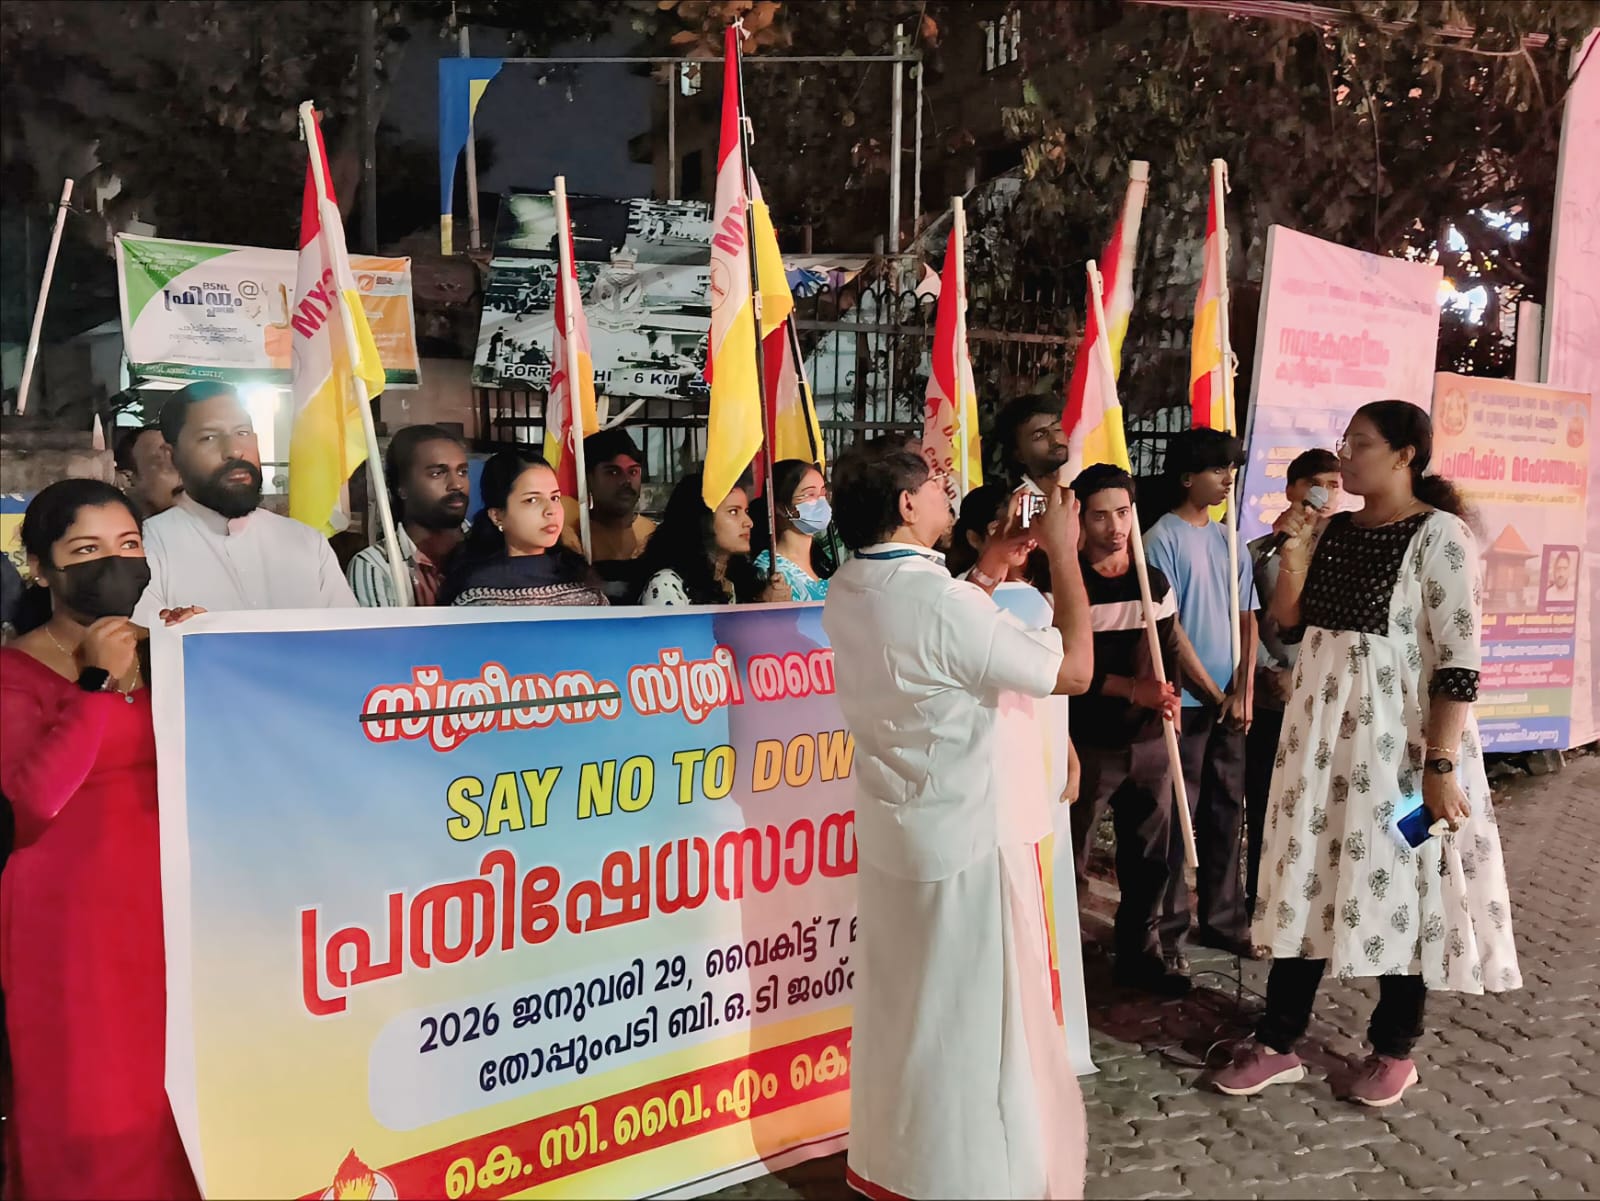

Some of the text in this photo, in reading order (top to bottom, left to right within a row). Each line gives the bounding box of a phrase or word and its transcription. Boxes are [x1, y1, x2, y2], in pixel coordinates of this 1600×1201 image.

[203, 282, 231, 292] BSNL
[503, 364, 550, 379] FORT
[634, 372, 644, 384] 6
[650, 372, 678, 386] KM
[359, 661, 621, 752] സ്ത്രീധനം
[627, 644, 744, 724] സ്ത്രീ
[446, 730, 856, 841] SAY NO TO DOW
[301, 810, 858, 1016] പ്രതിഷേധസായ
[420, 1002, 500, 1054] 2026
[512, 958, 644, 1029] ജനുവരി
[654, 955, 692, 992] 29,
[705, 916, 822, 978] വൈകിട്ട്
[827, 917, 841, 948] 7
[479, 1005, 658, 1092] തോപ്പുംപടി
[787, 956, 855, 1006] ജംഗ്
